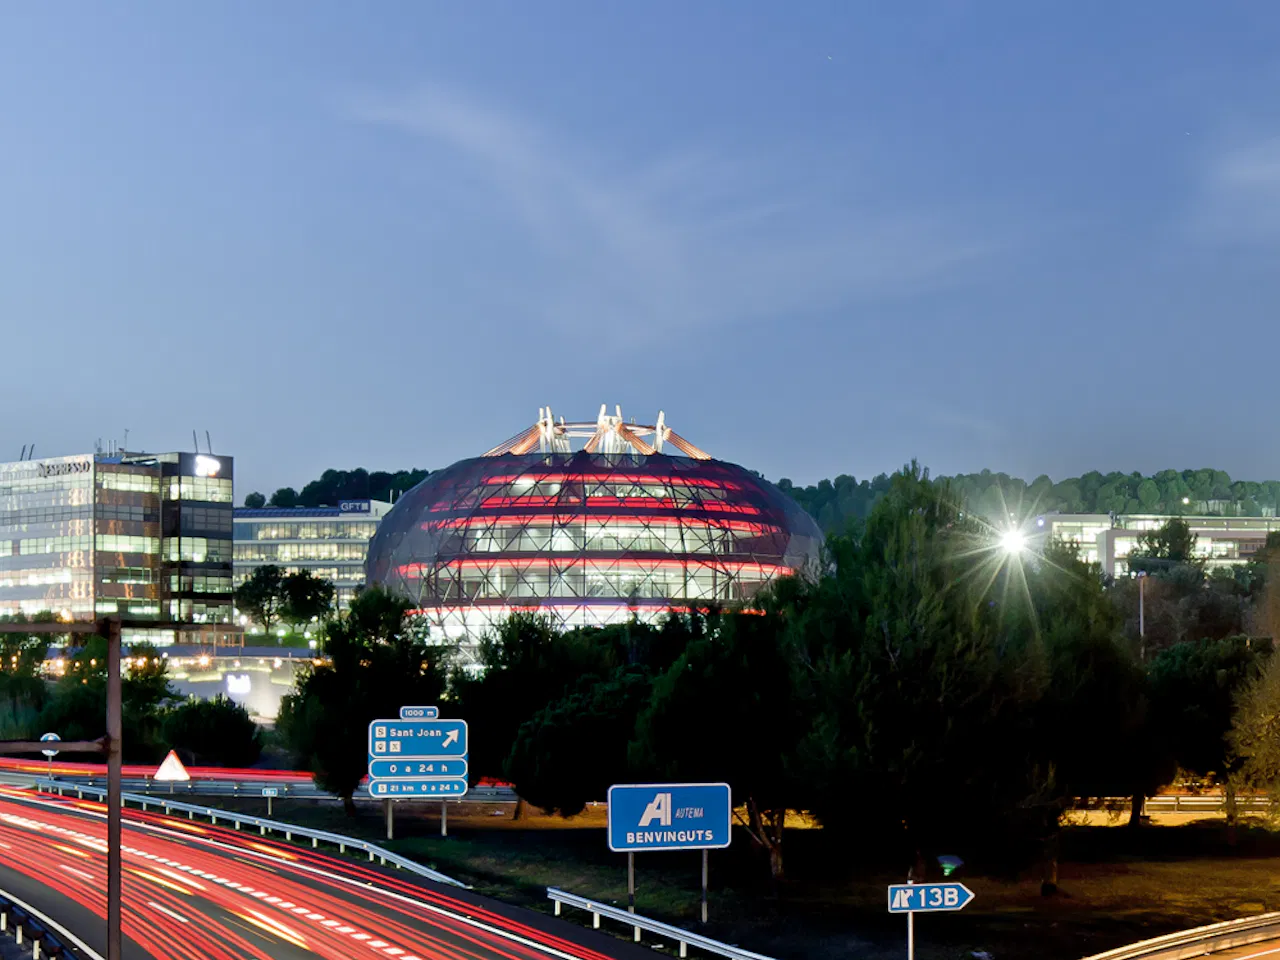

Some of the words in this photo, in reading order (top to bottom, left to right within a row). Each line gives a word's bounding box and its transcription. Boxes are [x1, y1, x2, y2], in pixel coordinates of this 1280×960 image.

[38, 460, 91, 478] NESPRESSO
[341, 502, 361, 511] GFT
[405, 709, 424, 717] 1000
[390, 728, 413, 736] Sant
[417, 728, 441, 736] Joan
[390, 764, 397, 773] 0
[419, 764, 434, 772] 24
[441, 764, 448, 772] h
[675, 807, 704, 819] AUTEMA
[626, 830, 714, 844] BENVINGUTS
[919, 887, 959, 907] 13B
